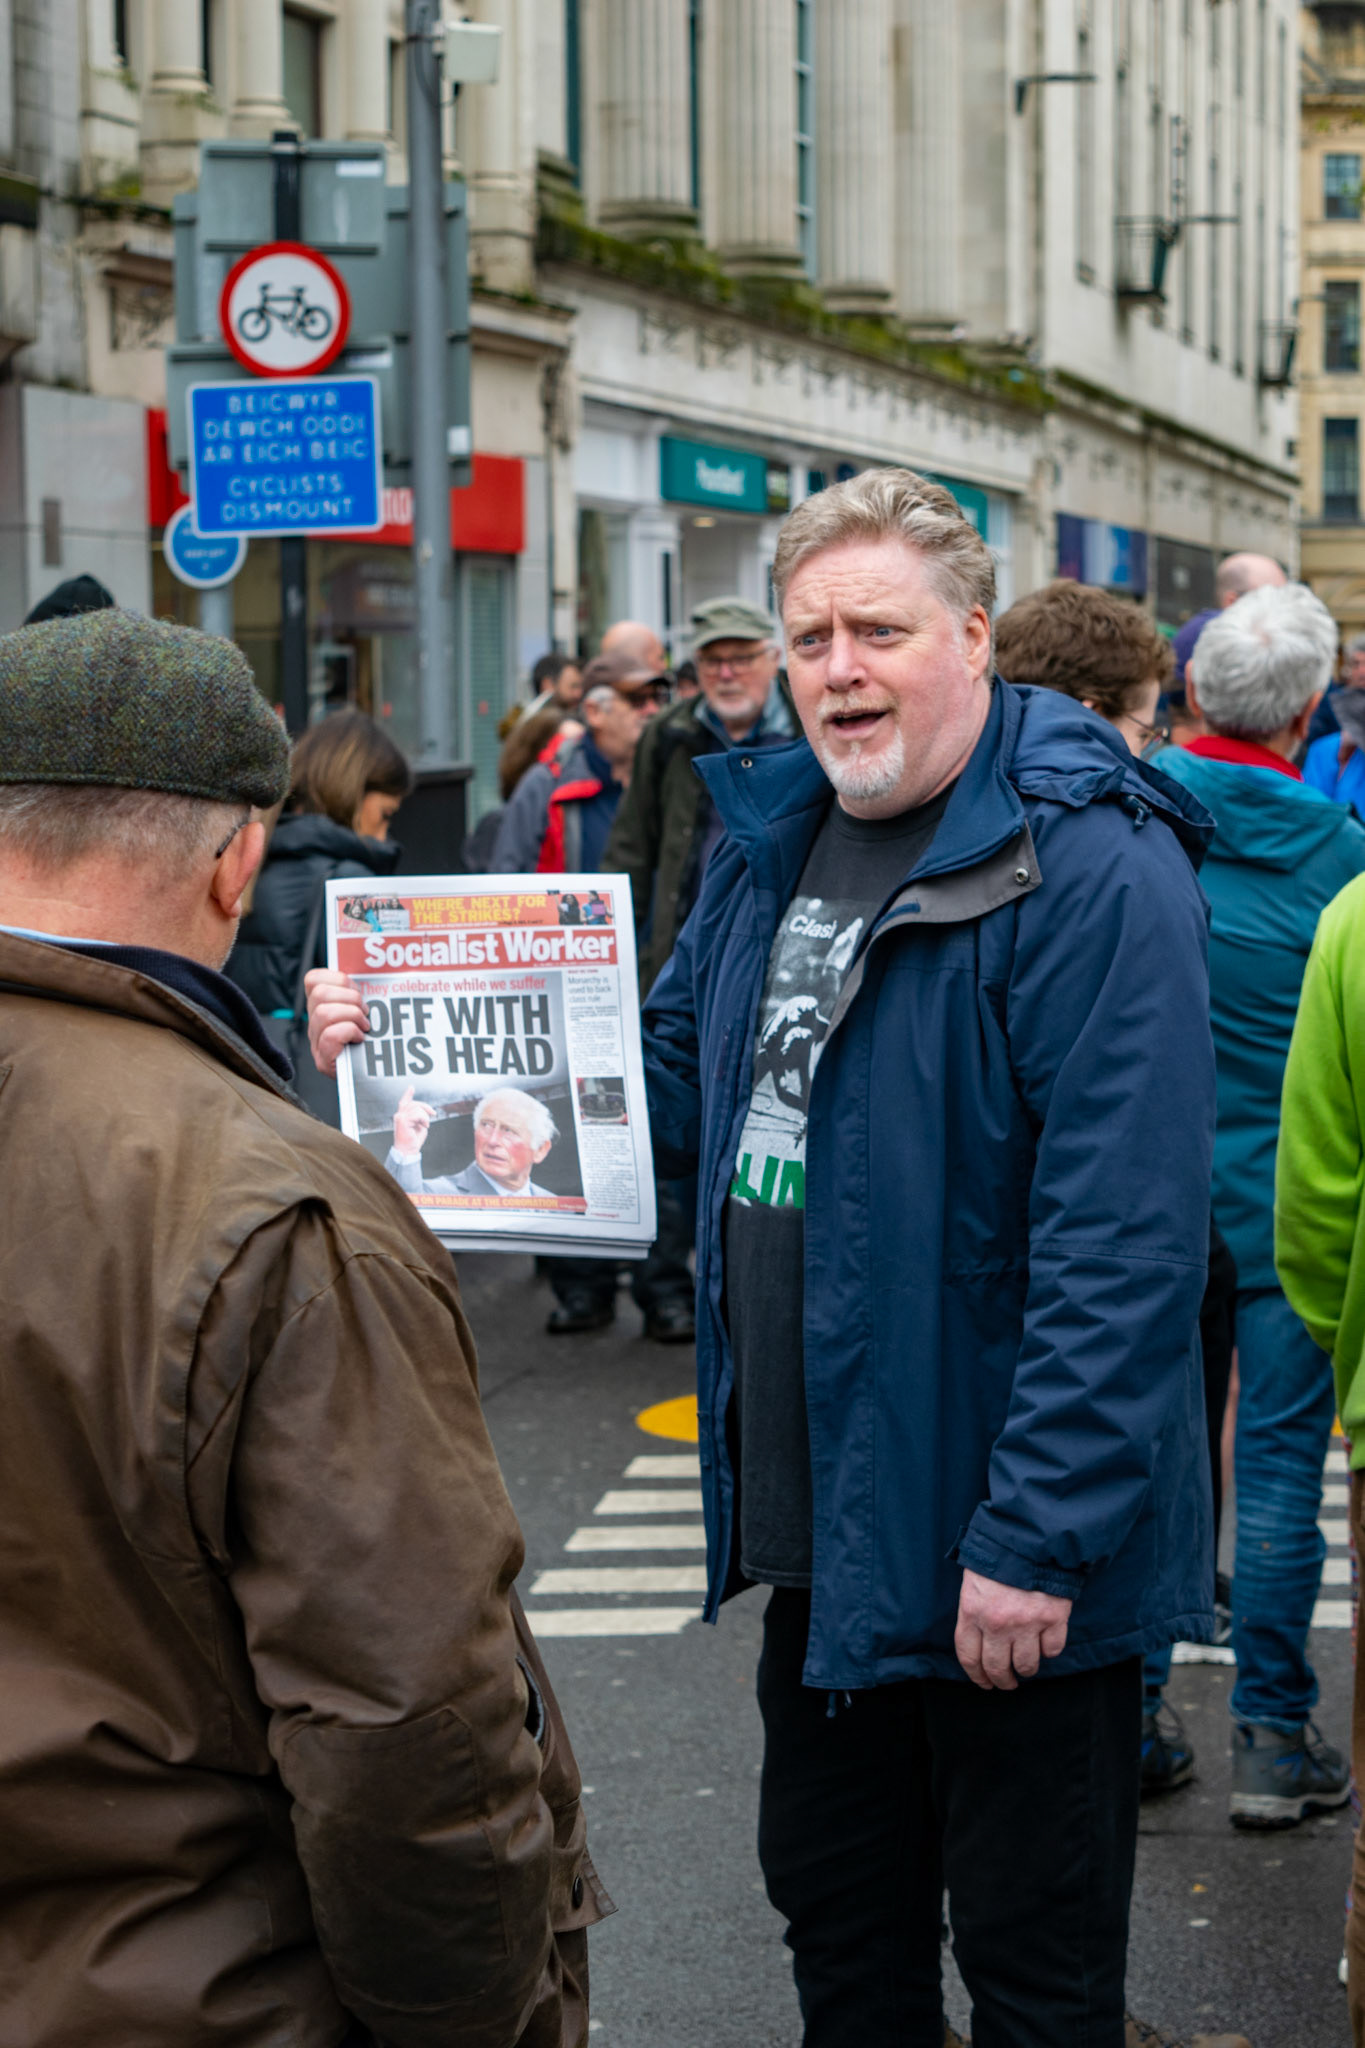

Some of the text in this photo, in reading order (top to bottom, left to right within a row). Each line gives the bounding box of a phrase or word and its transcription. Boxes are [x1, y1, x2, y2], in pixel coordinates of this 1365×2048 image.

[228, 391, 338, 414] BEICWYR
[204, 415, 364, 439] DEWCH ODDI
[204, 439, 368, 462] AR EICH BEIC
[229, 474, 342, 497] CYCLISTS
[222, 498, 351, 521] DISMOUNT
[412, 895, 547, 911] WHERE NEXT FOR
[413, 910, 443, 924] THE
[449, 908, 521, 923] STRIKES?
[363, 929, 614, 969] Socialist Worker
[360, 976, 547, 997] They celebrate while we suffer
[366, 997, 433, 1039] OFF
[443, 994, 550, 1035] WITH
[365, 1036, 434, 1077] HIS
[445, 1036, 554, 1076] HEAD
